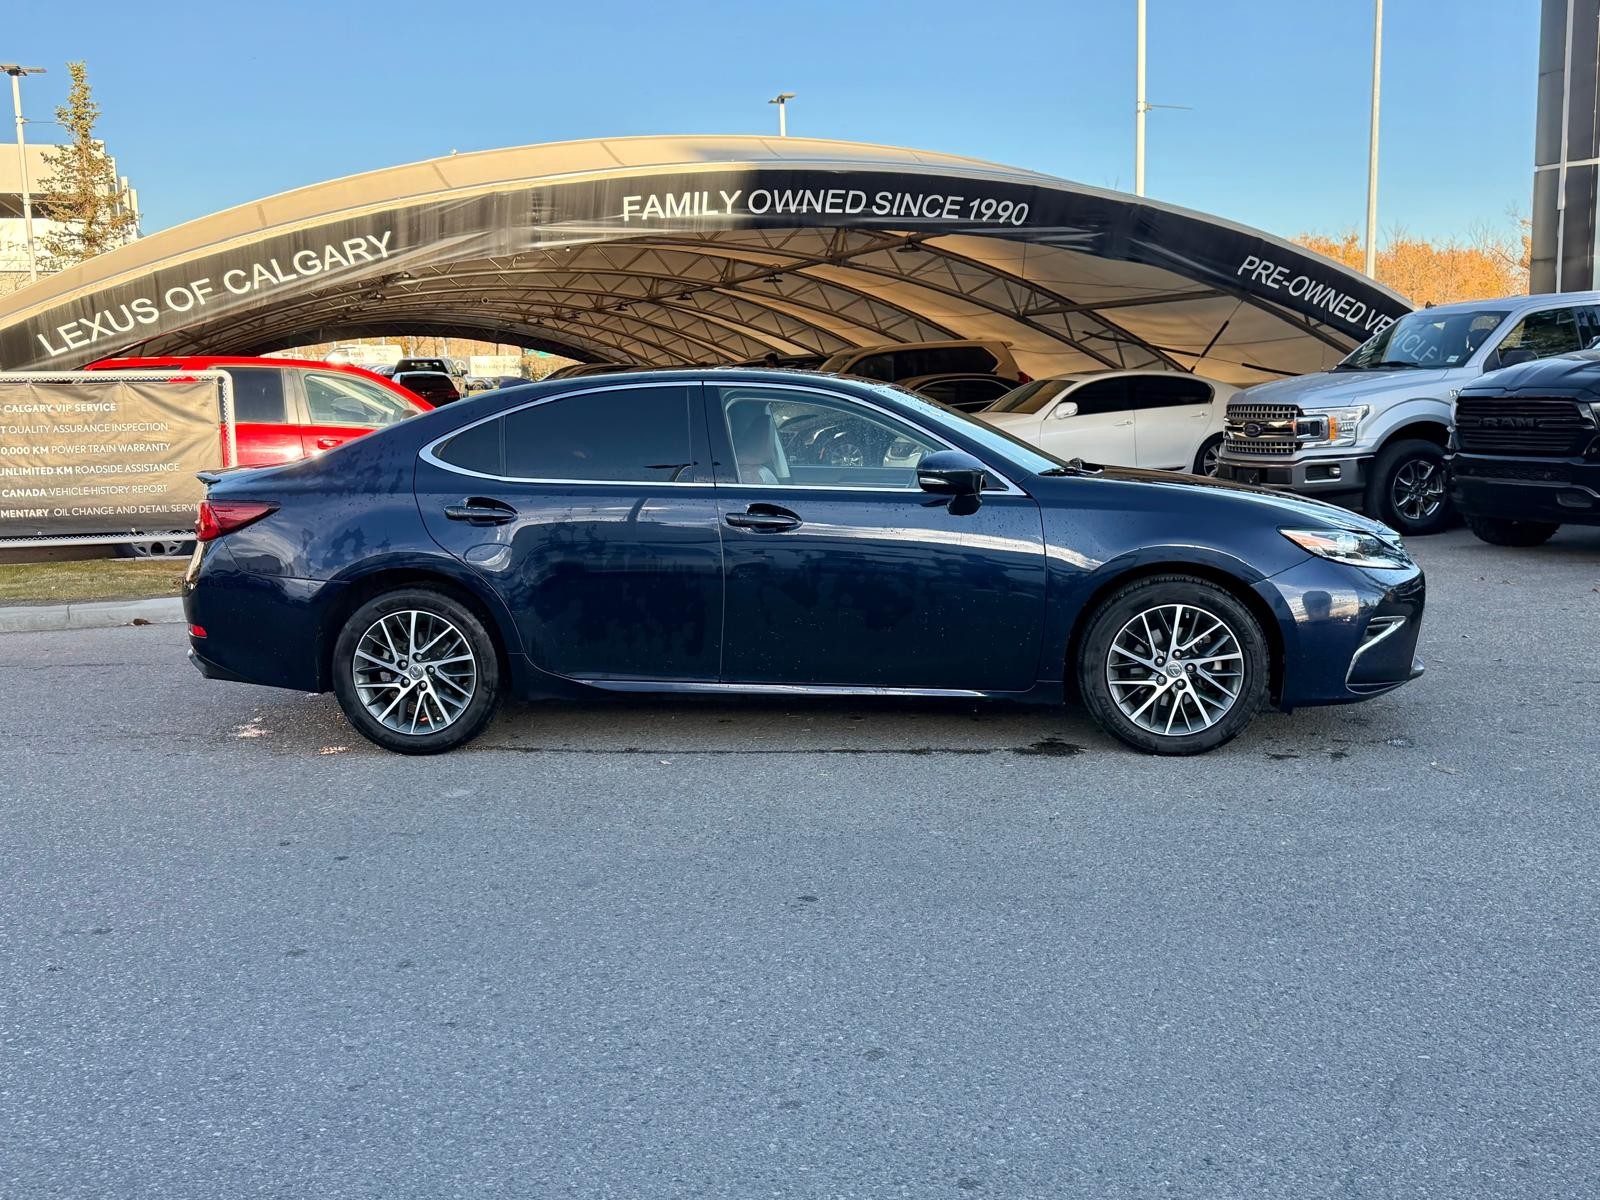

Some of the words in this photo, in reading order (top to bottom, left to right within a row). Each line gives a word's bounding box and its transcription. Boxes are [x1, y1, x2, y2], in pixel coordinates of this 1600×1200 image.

[623, 190, 741, 221] FAMILY
[747, 189, 867, 215] OWNED
[872, 191, 964, 220] SINCE
[968, 198, 1029, 226] 1990
[37, 298, 160, 357] LEXUS
[164, 278, 214, 312] OF
[223, 231, 392, 295] CALGARY
[1237, 255, 1365, 324] PRE-OWNED
[4, 403, 52, 413] CALGARY
[56, 403, 72, 412] VIP
[75, 402, 117, 412] SERVICE
[9, 425, 50, 434] QUALITY
[53, 424, 110, 433] ASSURANCE
[112, 422, 169, 432] INSPECTION
[1482, 416, 1535, 429] RAM
[33, 446, 49, 455] KM
[52, 445, 86, 454] POWER
[88, 444, 116, 453] TRAIN
[118, 443, 171, 452] WARRANTY
[0, 466, 54, 476] UNLIMITED
[57, 466, 73, 475] KM
[75, 464, 122, 474] ROADSIDE
[125, 463, 180, 473] ASSISTANCE
[2, 488, 47, 498] CANADA
[132, 484, 168, 494] REPORT
[54, 507, 70, 517] OIL
[72, 506, 114, 516] CHANGE
[117, 505, 137, 515] AND
[139, 504, 169, 514] DETAIL
